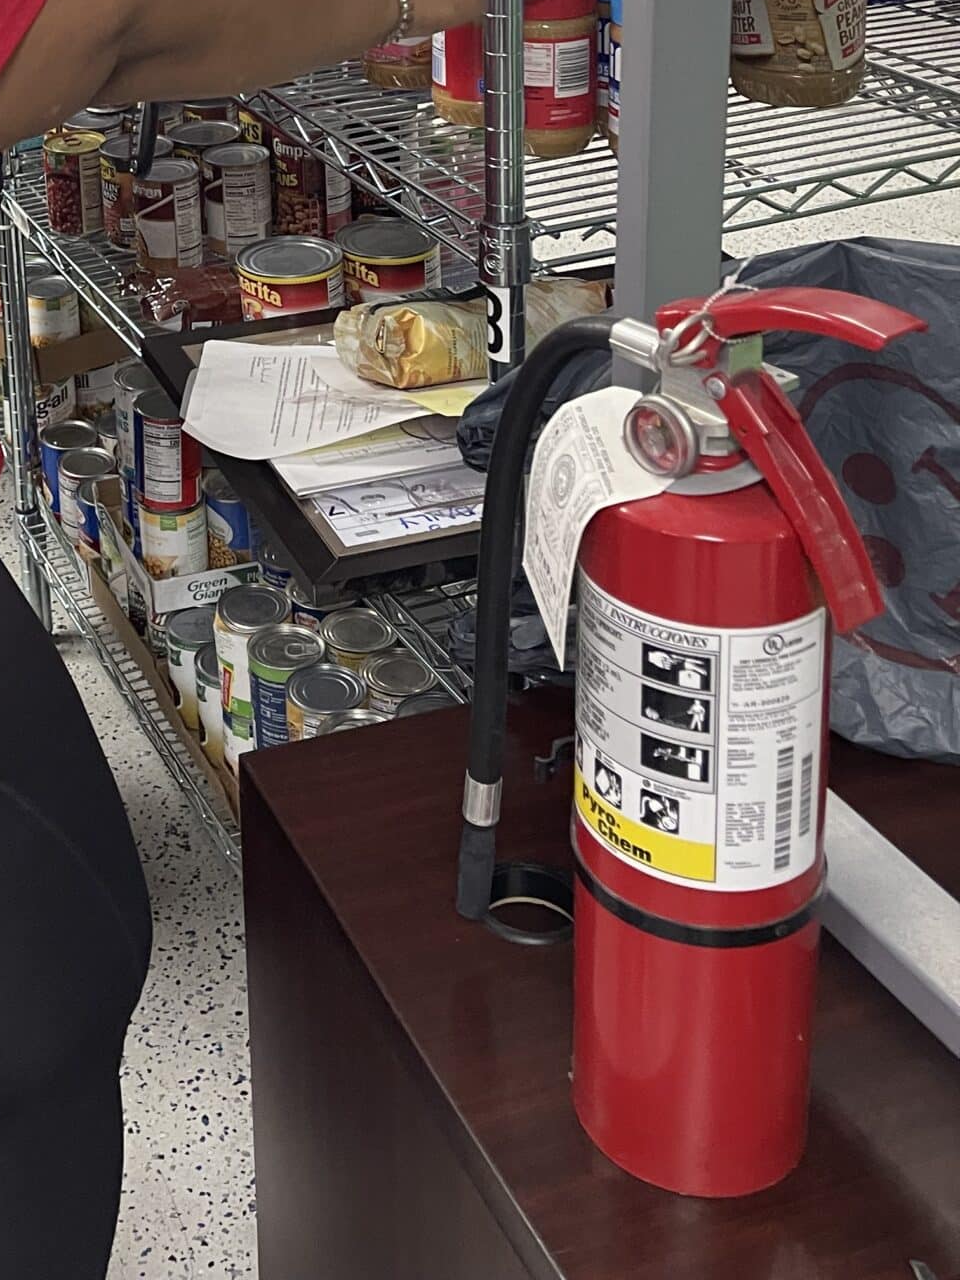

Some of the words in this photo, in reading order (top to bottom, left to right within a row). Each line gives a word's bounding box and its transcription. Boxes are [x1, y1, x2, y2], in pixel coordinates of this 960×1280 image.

[187, 576, 228, 592] Green
[610, 607, 709, 649] INSTRUCCIONES
[597, 818, 652, 862] Chem
